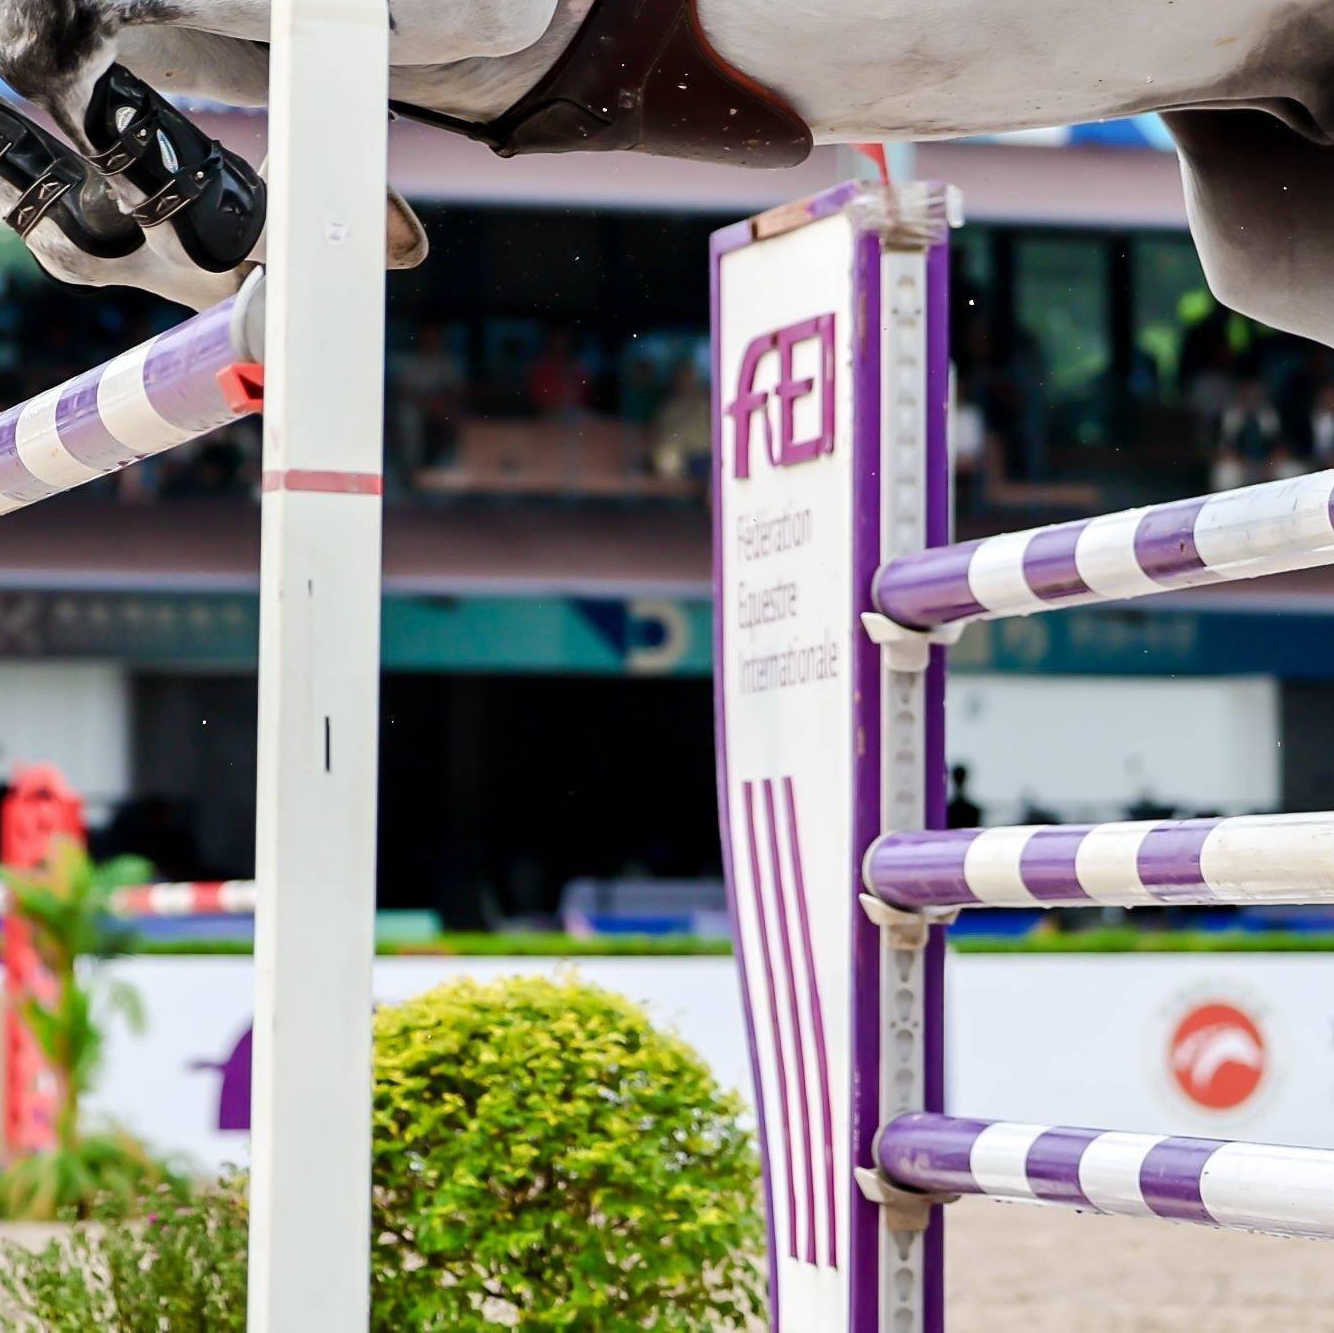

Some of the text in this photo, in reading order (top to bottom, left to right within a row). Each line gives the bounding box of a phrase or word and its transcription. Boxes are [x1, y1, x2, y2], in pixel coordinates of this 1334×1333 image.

[725, 312, 836, 479] FEI
[737, 578, 798, 643] Equestre
[738, 629, 840, 695] Internationale
